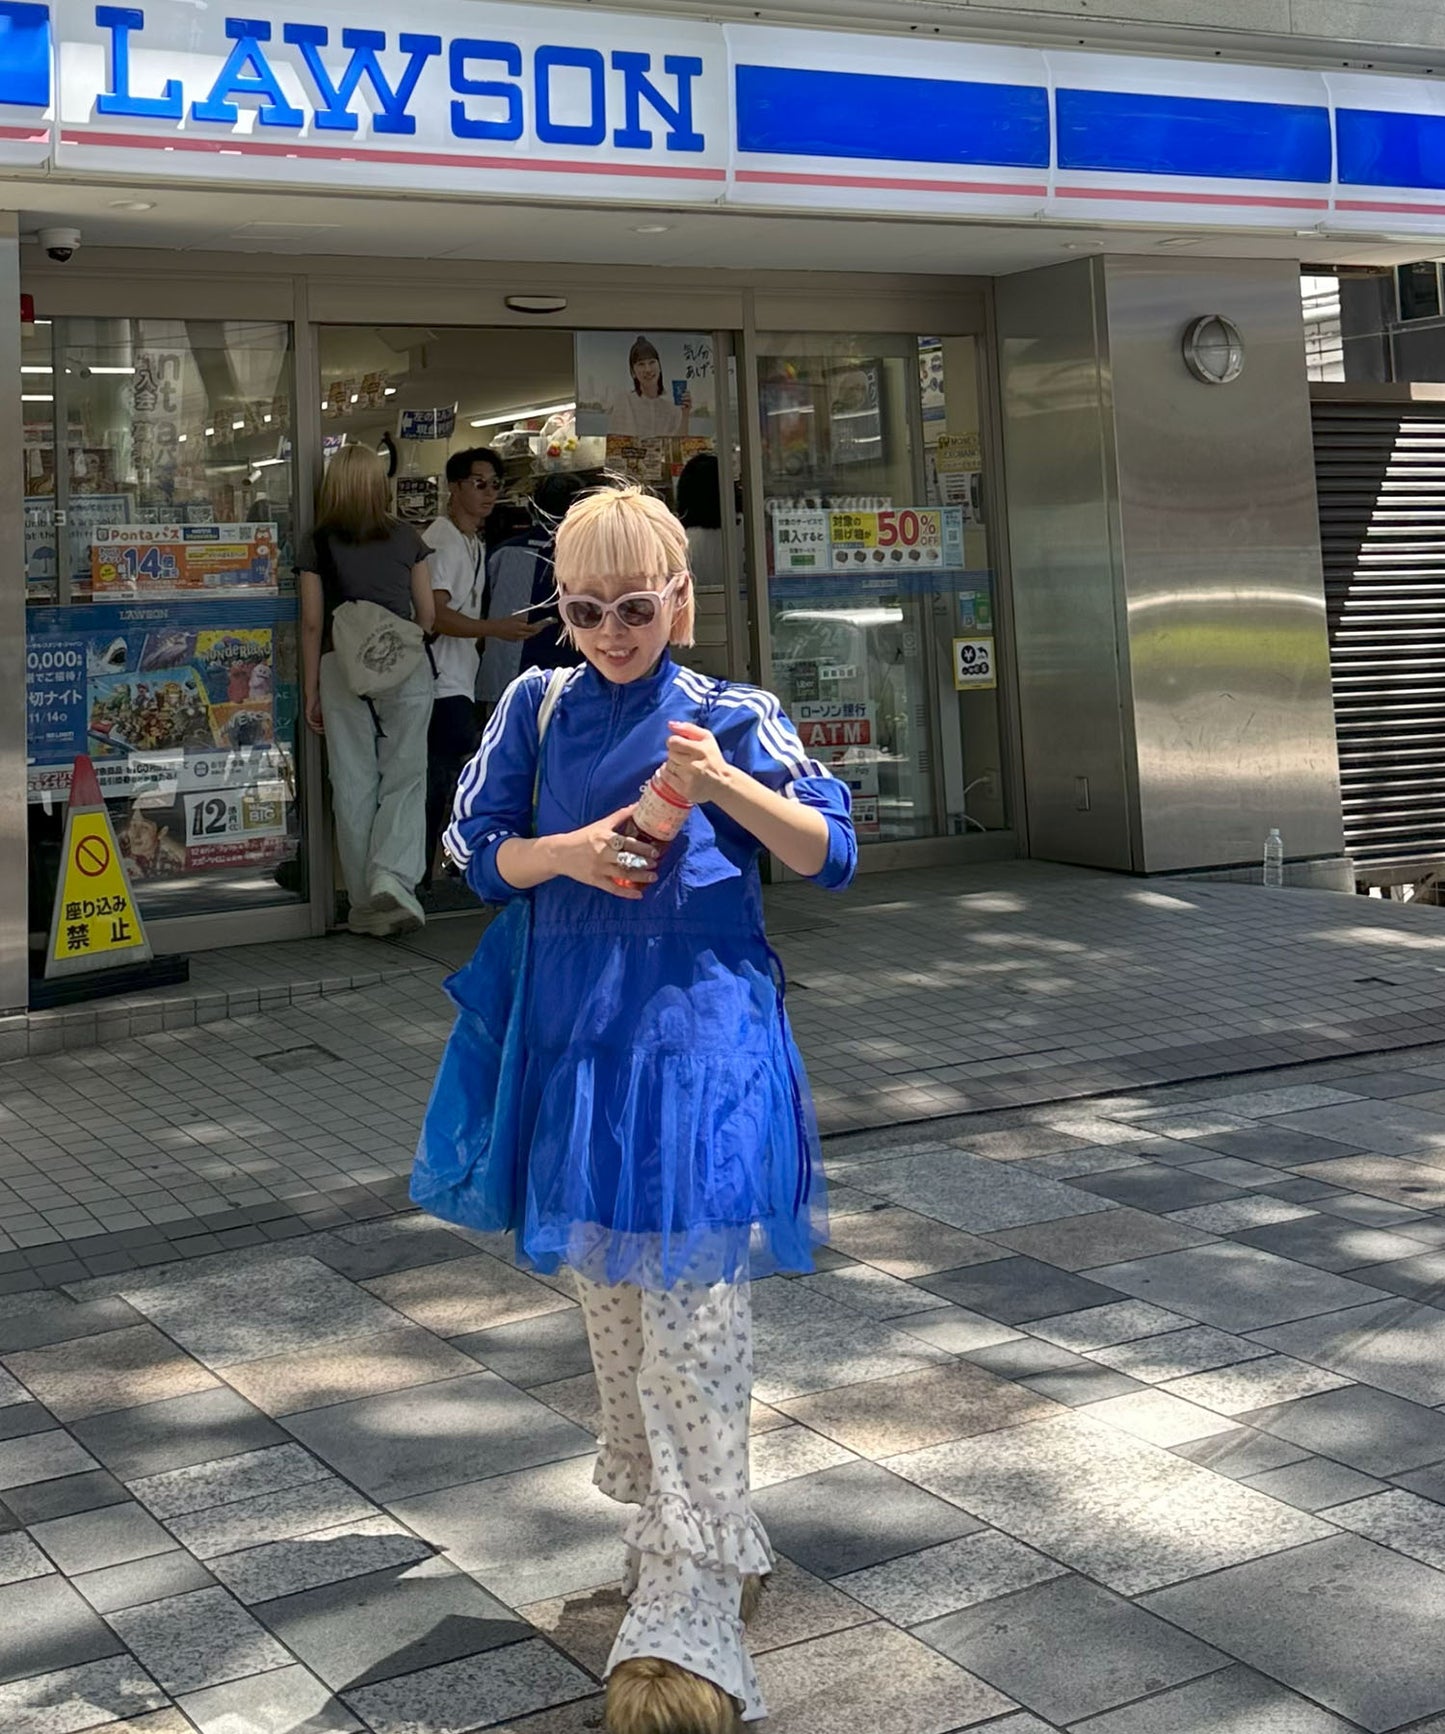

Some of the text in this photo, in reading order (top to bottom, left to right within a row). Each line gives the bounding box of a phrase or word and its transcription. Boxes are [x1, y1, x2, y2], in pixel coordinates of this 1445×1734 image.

[96, 5, 704, 152] LAWSON
[111, 526, 180, 541] Pontaパス
[778, 529, 824, 544] 購入すると
[801, 703, 866, 718] ローソン銀行
[809, 722, 861, 745] ATM
[249, 809, 276, 822] BIG
[65, 895, 127, 919] 座り込み
[67, 917, 131, 950] 禁止
